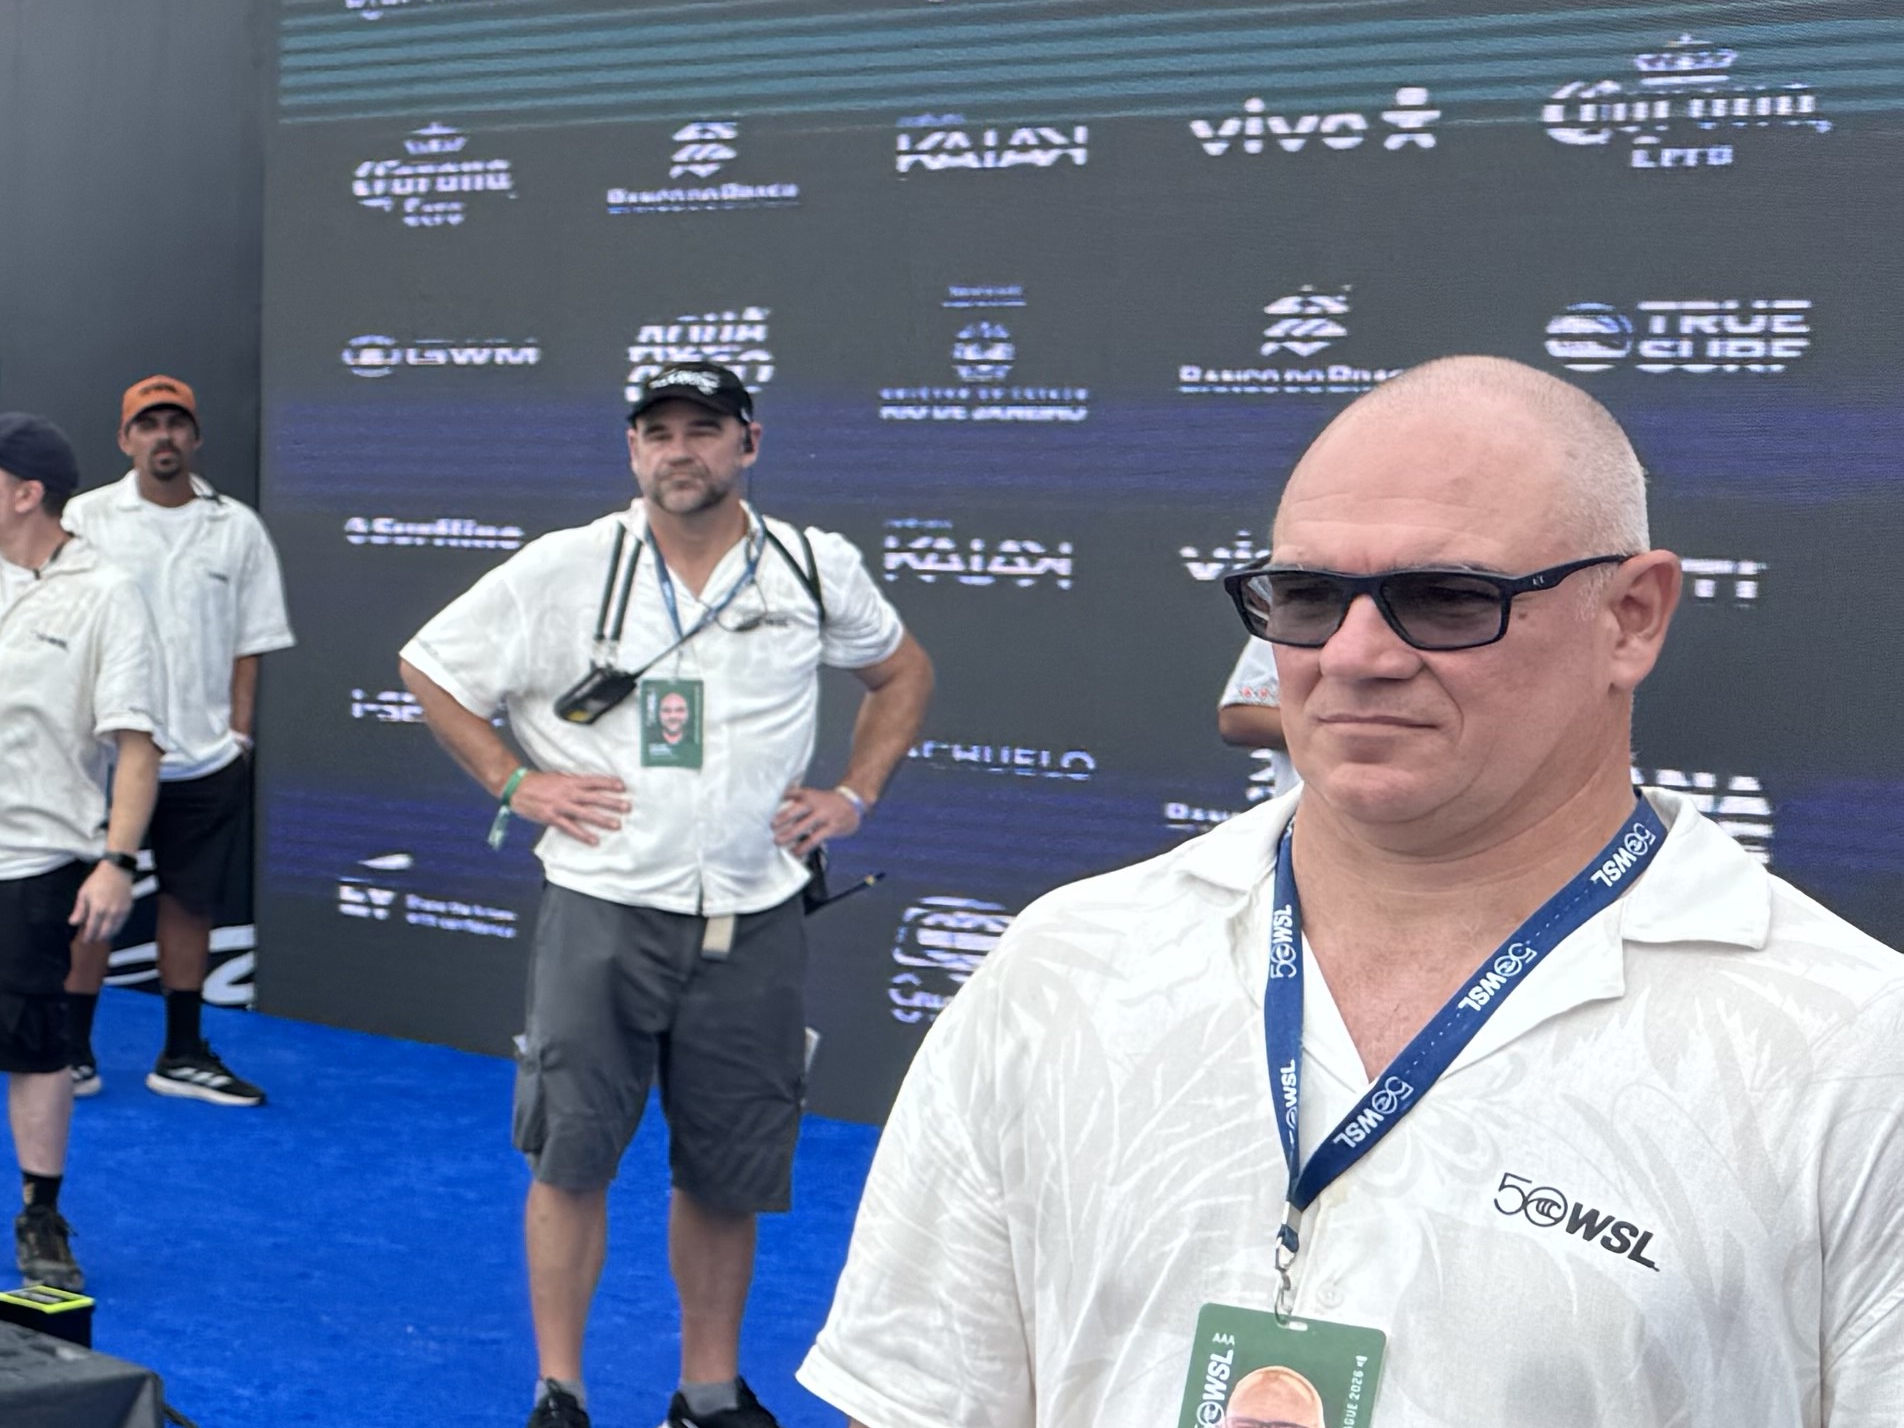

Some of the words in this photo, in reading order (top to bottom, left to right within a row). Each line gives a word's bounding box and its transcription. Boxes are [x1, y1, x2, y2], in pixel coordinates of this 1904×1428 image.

[1189, 97, 1370, 156] vivo
[1591, 846, 1638, 887] WSL
[1272, 903, 1293, 942] WSL
[1457, 971, 1507, 1013] WSL
[1333, 1106, 1385, 1149] WSL
[1564, 1200, 1660, 1272] WSL
[1202, 1348, 1234, 1404] WSL
